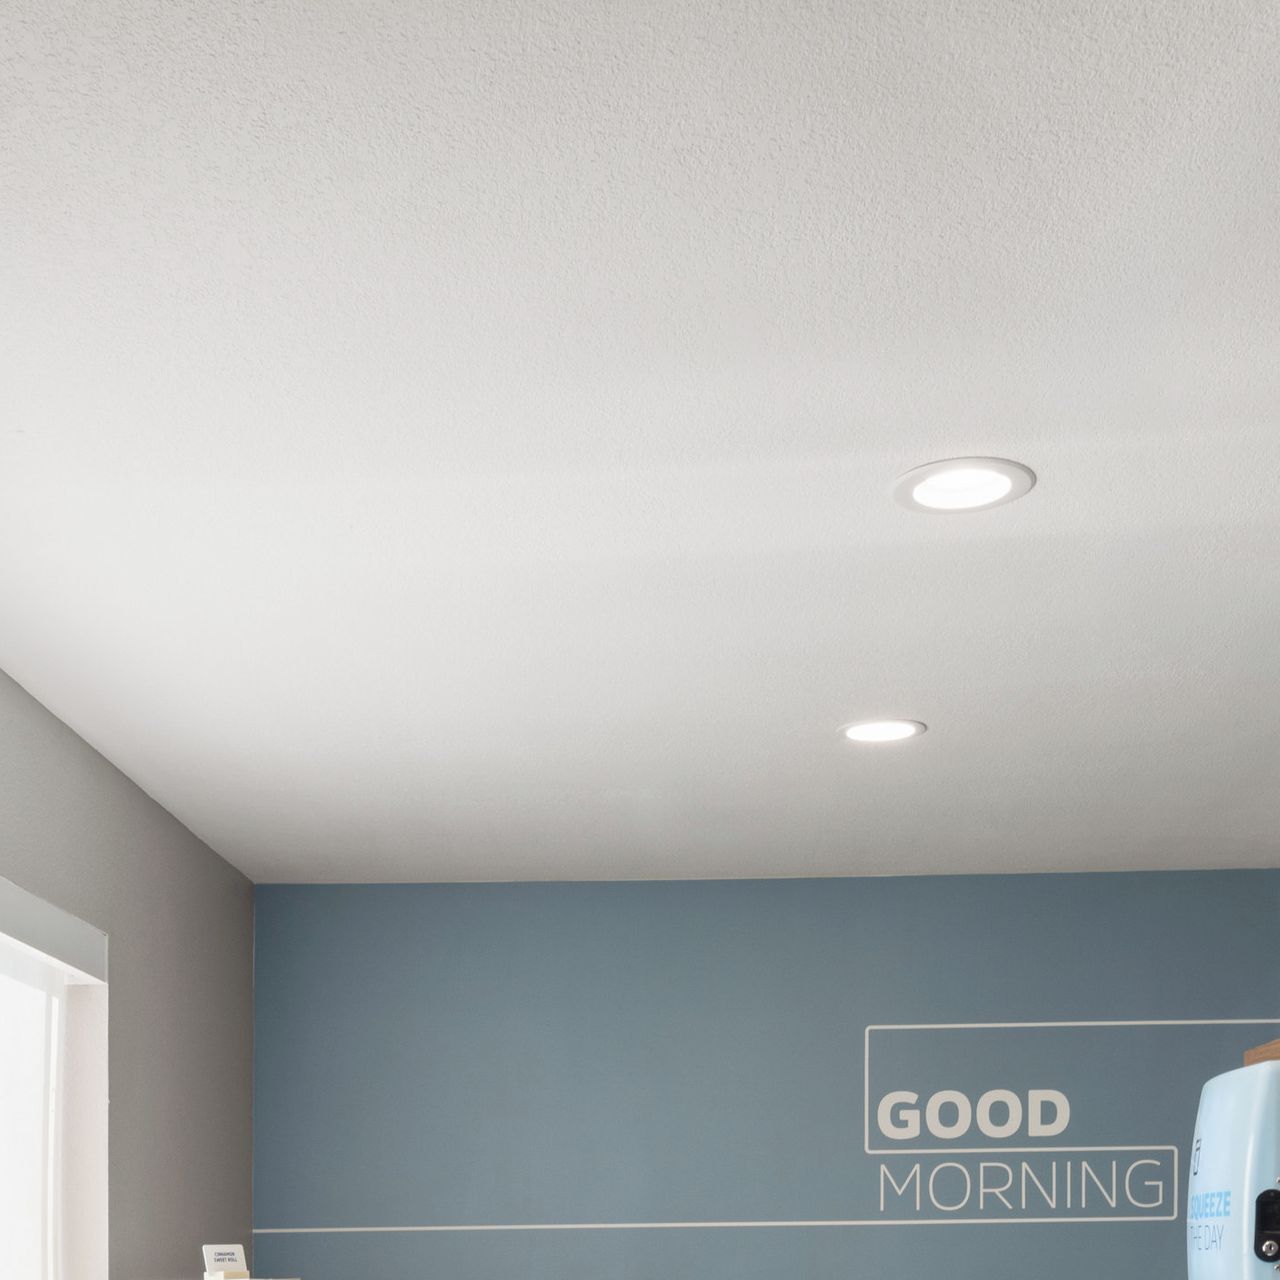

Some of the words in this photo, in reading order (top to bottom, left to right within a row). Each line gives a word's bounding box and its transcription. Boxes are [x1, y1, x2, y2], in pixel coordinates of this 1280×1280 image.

[876, 1088, 1071, 1140] GOOD
[879, 1159, 1164, 1212] MORNING
[1190, 1190, 1232, 1221] SQUEEZE
[1204, 1223, 1225, 1251] DAY
